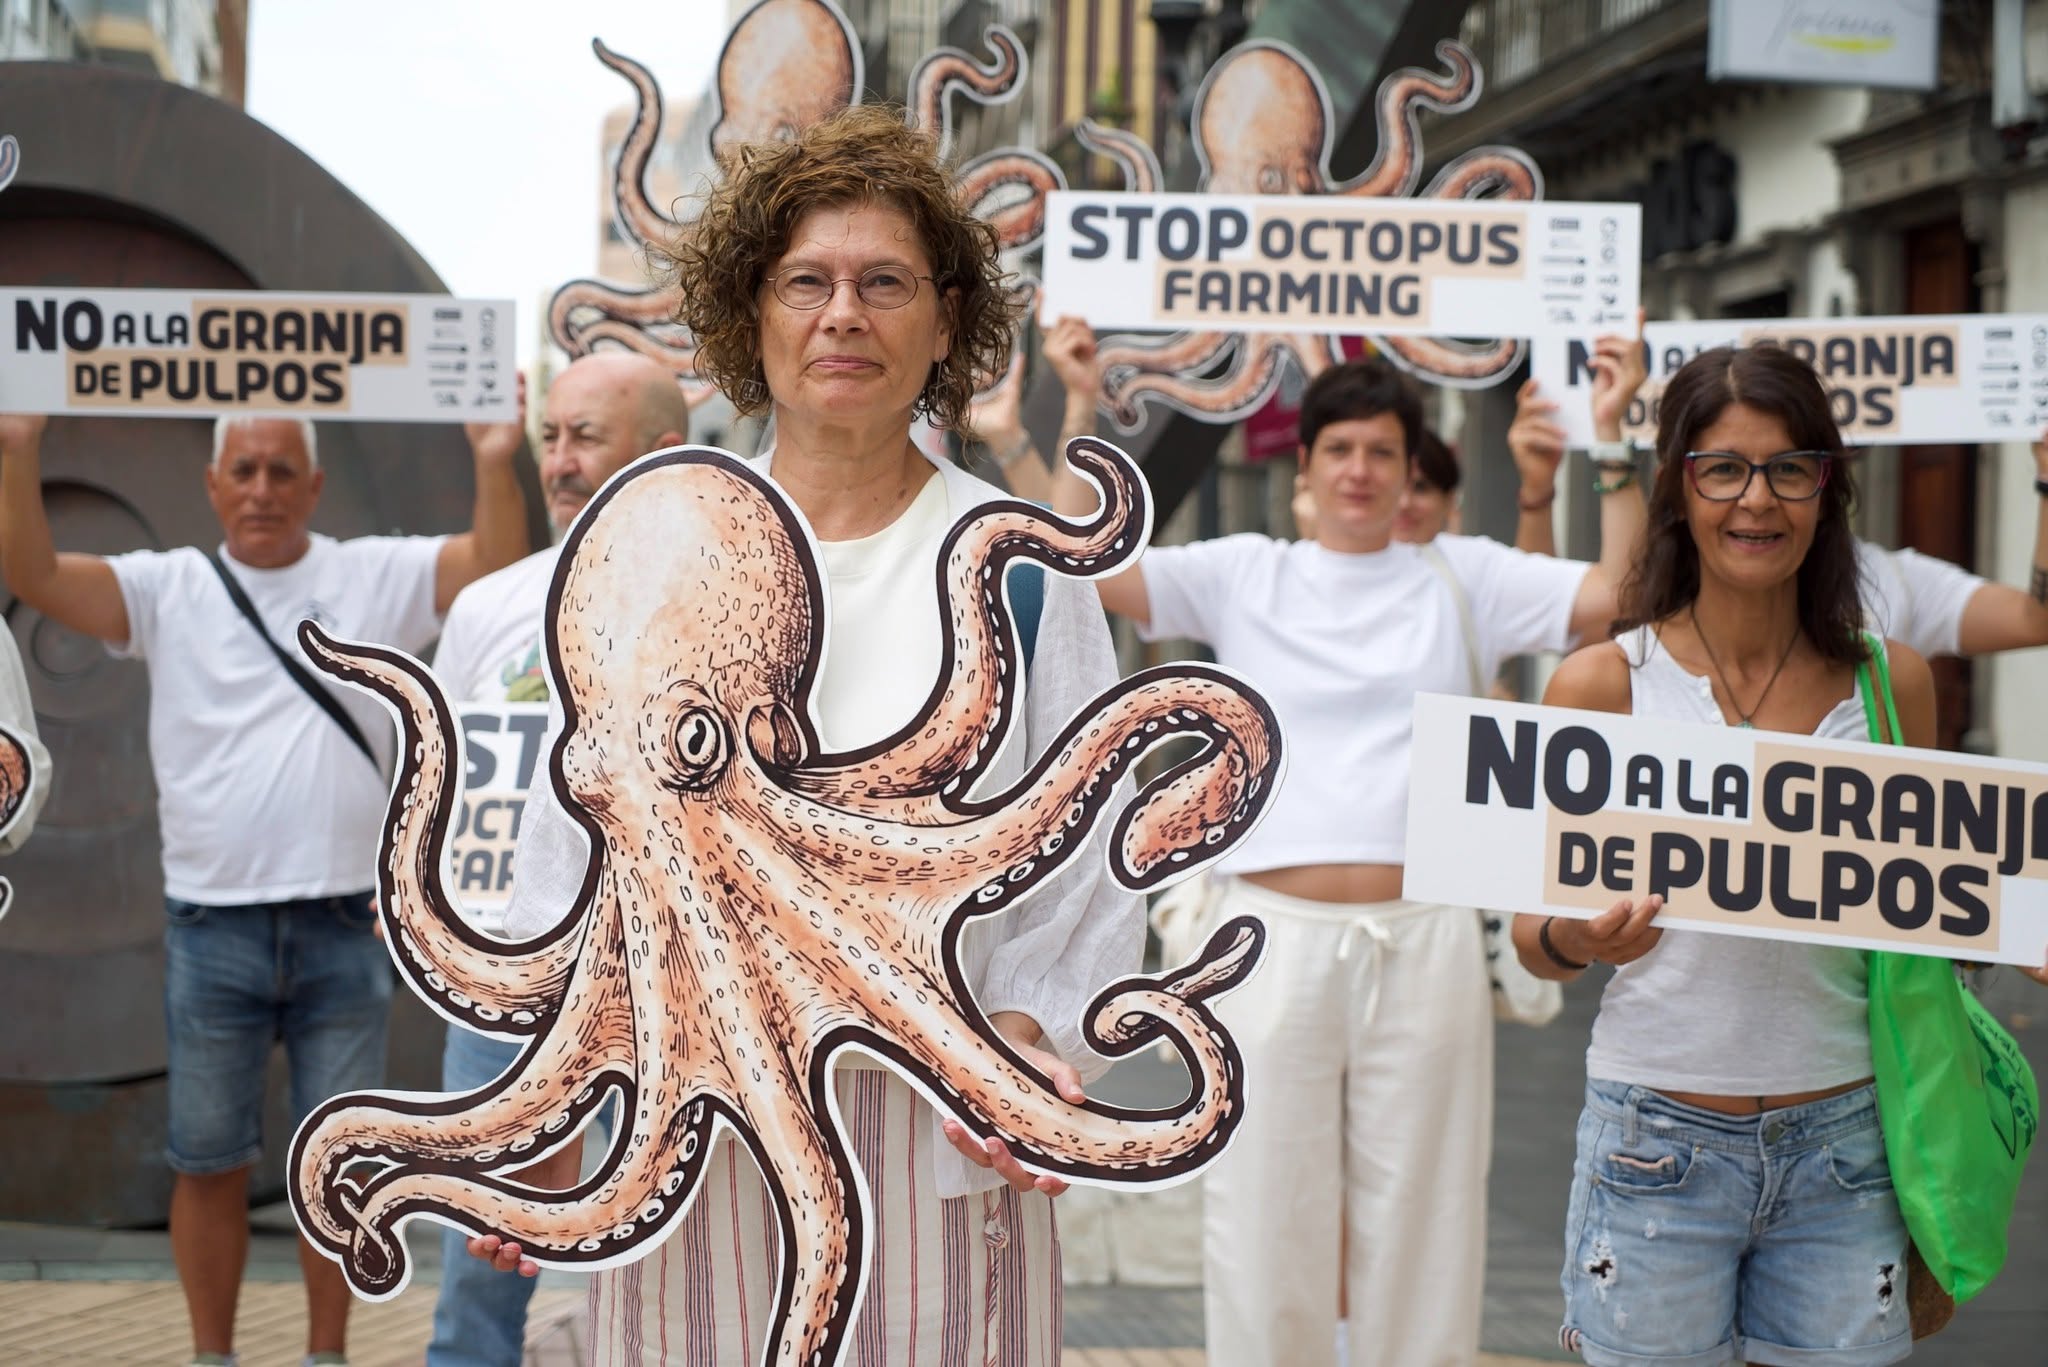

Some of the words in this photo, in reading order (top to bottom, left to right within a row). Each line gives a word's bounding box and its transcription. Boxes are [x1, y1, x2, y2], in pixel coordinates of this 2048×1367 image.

[1070, 205, 1249, 263] STOP
[1259, 218, 1520, 267] OCTOPUS
[1163, 269, 1420, 317] FARMING
[15, 299, 104, 354] NO
[112, 313, 136, 345] A
[144, 313, 189, 345] LA
[197, 308, 404, 365] GRANJA
[1568, 339, 1651, 386] N
[1752, 335, 1954, 387] RANJA
[74, 362, 121, 397] DE
[129, 357, 345, 405] PULPOS
[1465, 715, 1612, 816] NO
[1625, 754, 1664, 810] A
[1677, 759, 1749, 819] LA
[1762, 761, 2048, 876] GRANJ
[1558, 831, 1635, 892] DE
[1648, 832, 1990, 937] PULPOS
